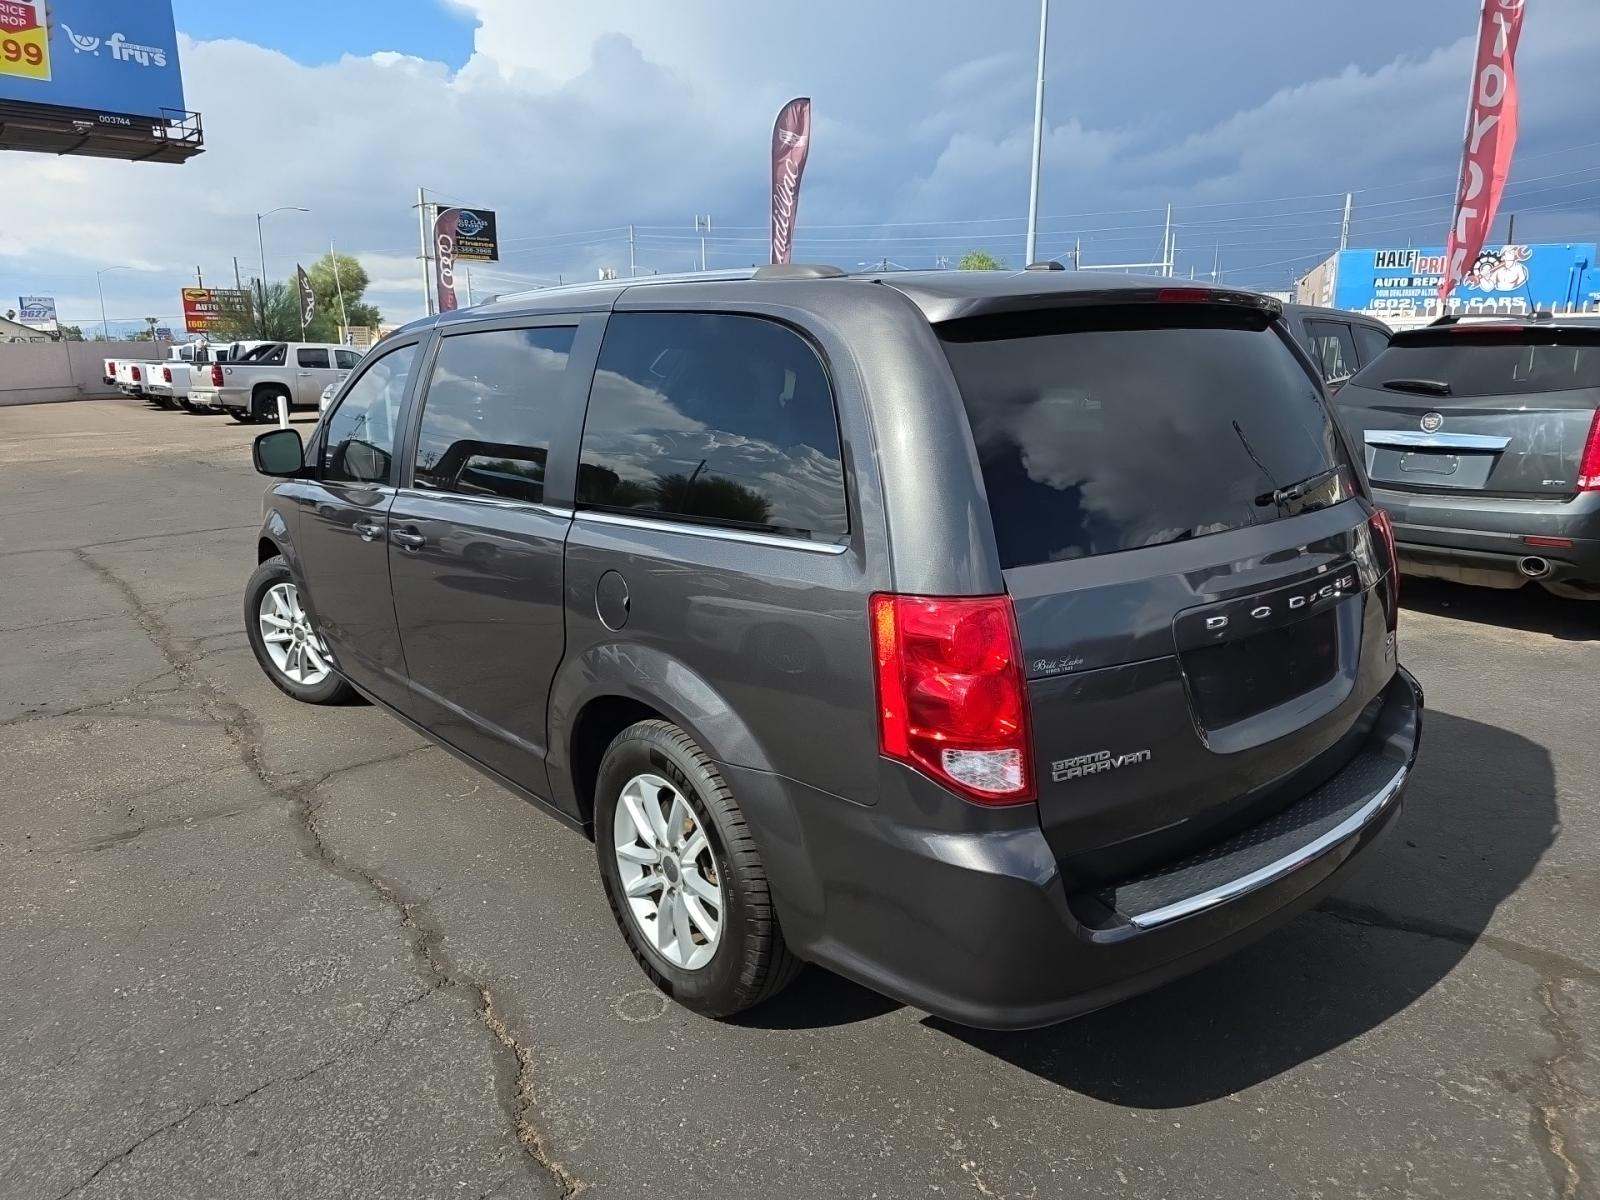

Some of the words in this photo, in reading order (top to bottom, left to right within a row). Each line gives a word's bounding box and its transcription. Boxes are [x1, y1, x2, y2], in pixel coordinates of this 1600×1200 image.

[99, 115, 131, 126] 003744
[773, 158, 799, 263] adillac
[1375, 250, 1414, 268] HALF
[1374, 277, 1409, 288] AUTO
[1206, 575, 1353, 630] DODGE
[1052, 750, 1111, 772] GRAND
[1052, 749, 1151, 782] CARAVAN
